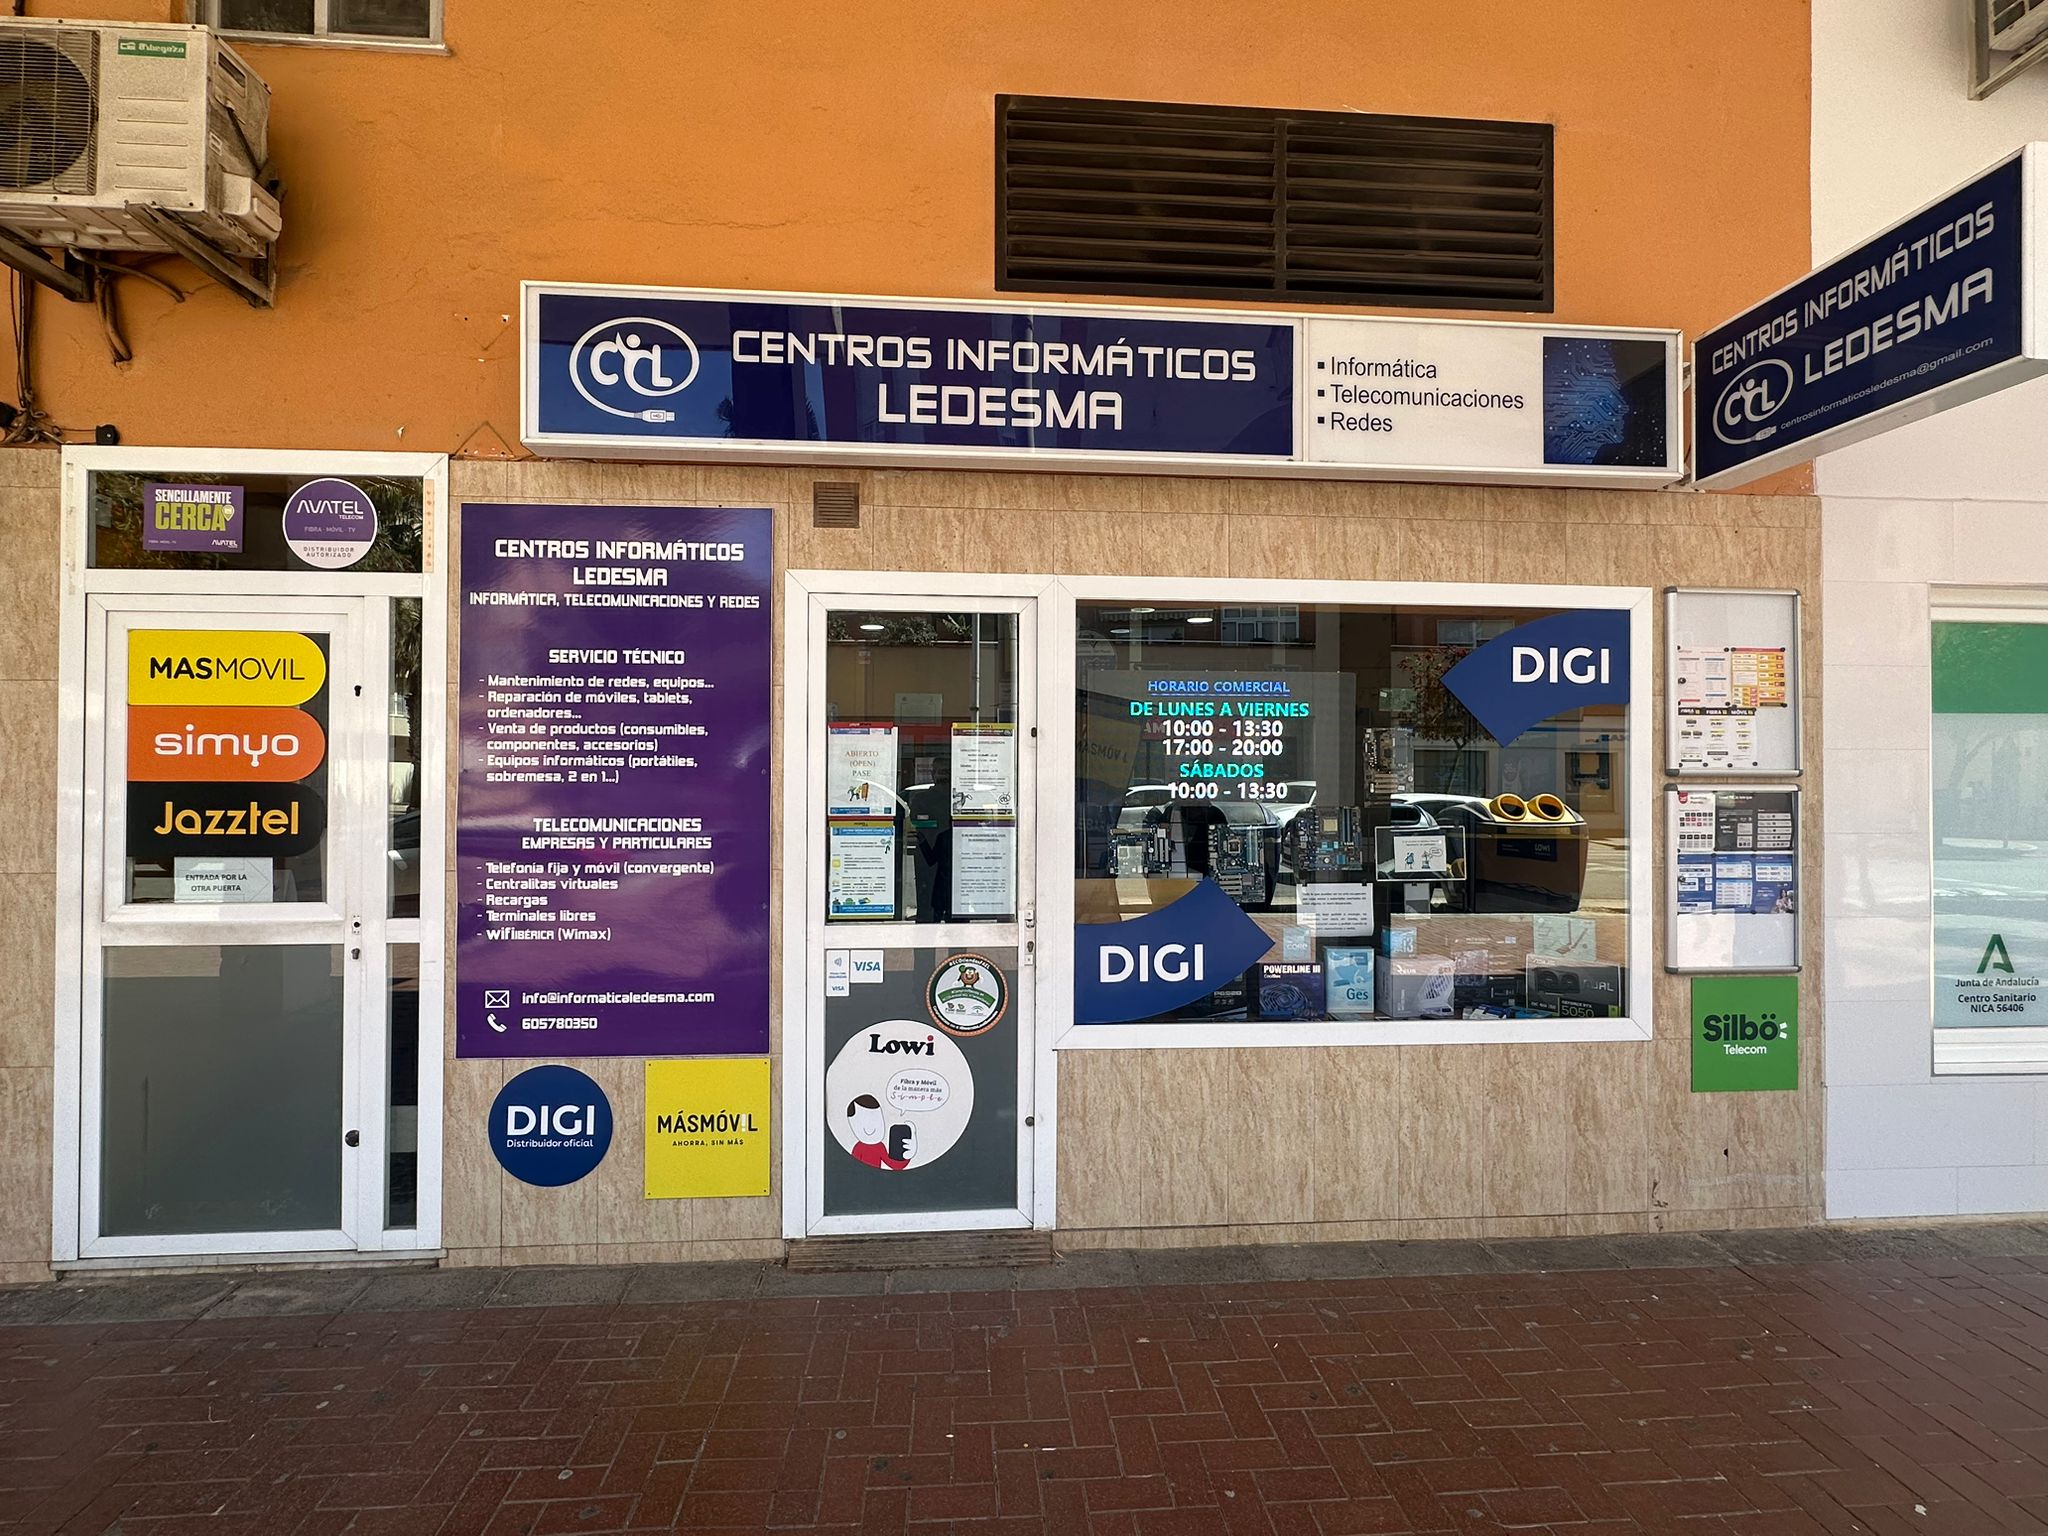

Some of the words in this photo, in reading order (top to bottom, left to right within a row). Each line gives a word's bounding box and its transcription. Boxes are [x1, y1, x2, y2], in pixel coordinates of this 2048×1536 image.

[1712, 308, 1798, 375] CENTROS
[1804, 201, 1994, 329] INFORMÁTICOS
[1804, 267, 1993, 385] LEDESMA
[733, 329, 932, 370] CENTROS
[947, 337, 1256, 381] INFORMÁTICOS
[1330, 356, 1437, 379] Informática
[1330, 384, 1524, 409] Telecomunicaciones
[878, 383, 1123, 430] LEDESMA
[1330, 411, 1393, 433] Redes
[155, 489, 232, 504] SENCILLAMENTE
[296, 500, 364, 514] AVATEL
[155, 502, 226, 531] CERCA
[495, 539, 590, 559] CENTROS
[596, 540, 744, 561] INFORMÁTICOS
[573, 566, 668, 587] LEDESMA
[470, 590, 560, 607] INFORMÁTICA,
[564, 594, 703, 608] TELECOMUNICACIONES
[708, 596, 716, 608] Y
[720, 596, 760, 609] REDES
[549, 649, 618, 664] SERVICIO
[622, 648, 685, 664] TÉCNICO
[150, 657, 305, 681] MASMOVIL
[1512, 646, 1610, 684] DIGI
[488, 675, 585, 688] Mantenimiento
[588, 676, 605, 688] de
[608, 676, 650, 690] redes,
[654, 677, 714, 691] equipos...
[1148, 680, 1209, 693] HORARIO
[1214, 681, 1290, 693] COMERCIAL
[488, 691, 561, 705] Reparación
[565, 692, 582, 704] de
[586, 692, 640, 705] móviles,
[644, 693, 693, 706] tablets,
[487, 708, 582, 719] ordenadores...
[1130, 702, 1153, 716] DE
[1158, 702, 1214, 717] LUNES
[1220, 702, 1233, 717] A
[1238, 702, 1310, 718] VIERNES
[488, 723, 526, 735] Venta
[530, 723, 546, 735] de
[550, 724, 616, 737] productos
[620, 724, 709, 737] (consumibles,
[1162, 720, 1214, 737] 10:00
[1232, 720, 1283, 737] 13:30
[154, 724, 299, 767] simyo
[487, 739, 580, 752] componentes,
[584, 739, 658, 752] accesorios)
[1162, 740, 1214, 756] 17:00
[1232, 740, 1283, 756] 20:00
[487, 754, 539, 769] Equipos
[543, 754, 625, 767] informáticos
[628, 755, 698, 769] (portátiles,
[1180, 760, 1264, 778] SÁBADOS
[486, 770, 565, 783] sobremesa,
[568, 771, 577, 782] 2
[581, 772, 597, 783] en
[601, 770, 620, 784] 1...)
[1169, 782, 1219, 799] 10:00
[1238, 782, 1288, 799] 13:30
[154, 801, 299, 835] Jazztel
[533, 818, 702, 832] TELECOMUNICACIONES
[522, 837, 595, 850] EMPRESAS
[599, 837, 609, 849] Y
[612, 837, 712, 850] PARTICULARES
[486, 862, 544, 875] Telefonía
[548, 862, 569, 876] fija
[572, 865, 581, 876] y
[585, 862, 620, 874] móvil
[623, 862, 715, 876] (convergente)
[486, 878, 556, 890] Centralitas
[560, 878, 618, 890] virtuales
[486, 894, 548, 908] Recargas
[486, 910, 556, 922] Terminales
[560, 910, 596, 922] libres
[558, 928, 611, 941] (Wimax)
[853, 961, 881, 971] VISA
[1100, 944, 1204, 983] DIGI
[1264, 965, 1311, 974] POWERLINE
[1312, 965, 1321, 973] III
[1955, 979, 1981, 987] Junta
[1982, 978, 1994, 987] de
[1995, 976, 2039, 987] Andalucía
[522, 991, 715, 1004] info@informaticaledesma.com
[1346, 988, 1369, 1001] Ges
[1958, 994, 1991, 1003] Centro
[1993, 993, 2037, 1002] Sanitario
[1562, 1006, 1594, 1018] 5050
[1970, 1004, 1995, 1013] NICA
[1996, 1004, 2024, 1012] 56406
[522, 1018, 598, 1030] 605780350
[1702, 1013, 1779, 1042] Silbö
[868, 1034, 935, 1056] Lowi
[1723, 1044, 1767, 1055] Telecom
[506, 1105, 595, 1136] DIGI
[506, 1138, 562, 1148] Distribuidor
[564, 1138, 594, 1148] oficial
[672, 1140, 708, 1148] AHORRA,
[711, 1139, 725, 1147] SIN
[728, 1138, 744, 1147] MÁS
